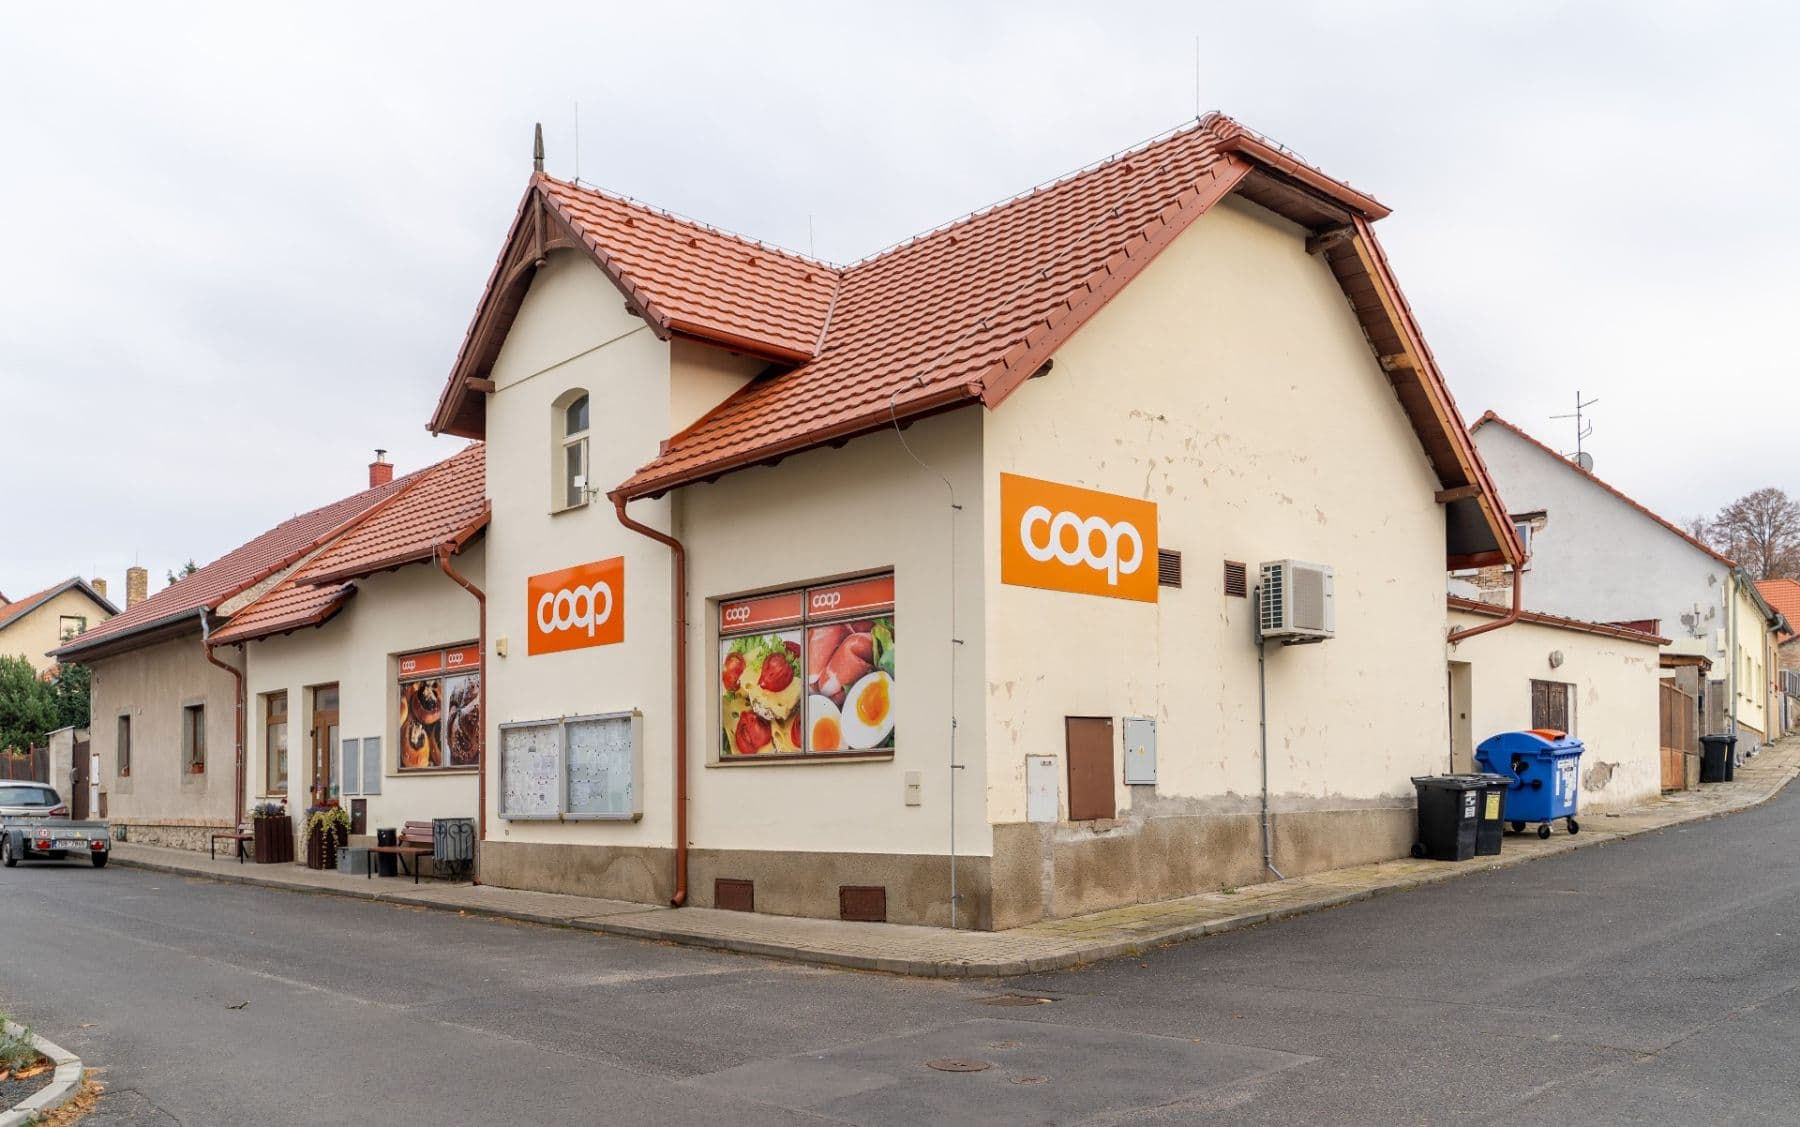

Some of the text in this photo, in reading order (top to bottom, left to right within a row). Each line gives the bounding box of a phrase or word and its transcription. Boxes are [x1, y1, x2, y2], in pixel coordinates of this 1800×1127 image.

[1021, 505, 1143, 585] coop
[812, 591, 841, 608] coop
[537, 581, 613, 637] coop
[726, 606, 750, 621] coop
[448, 652, 464, 664] coop
